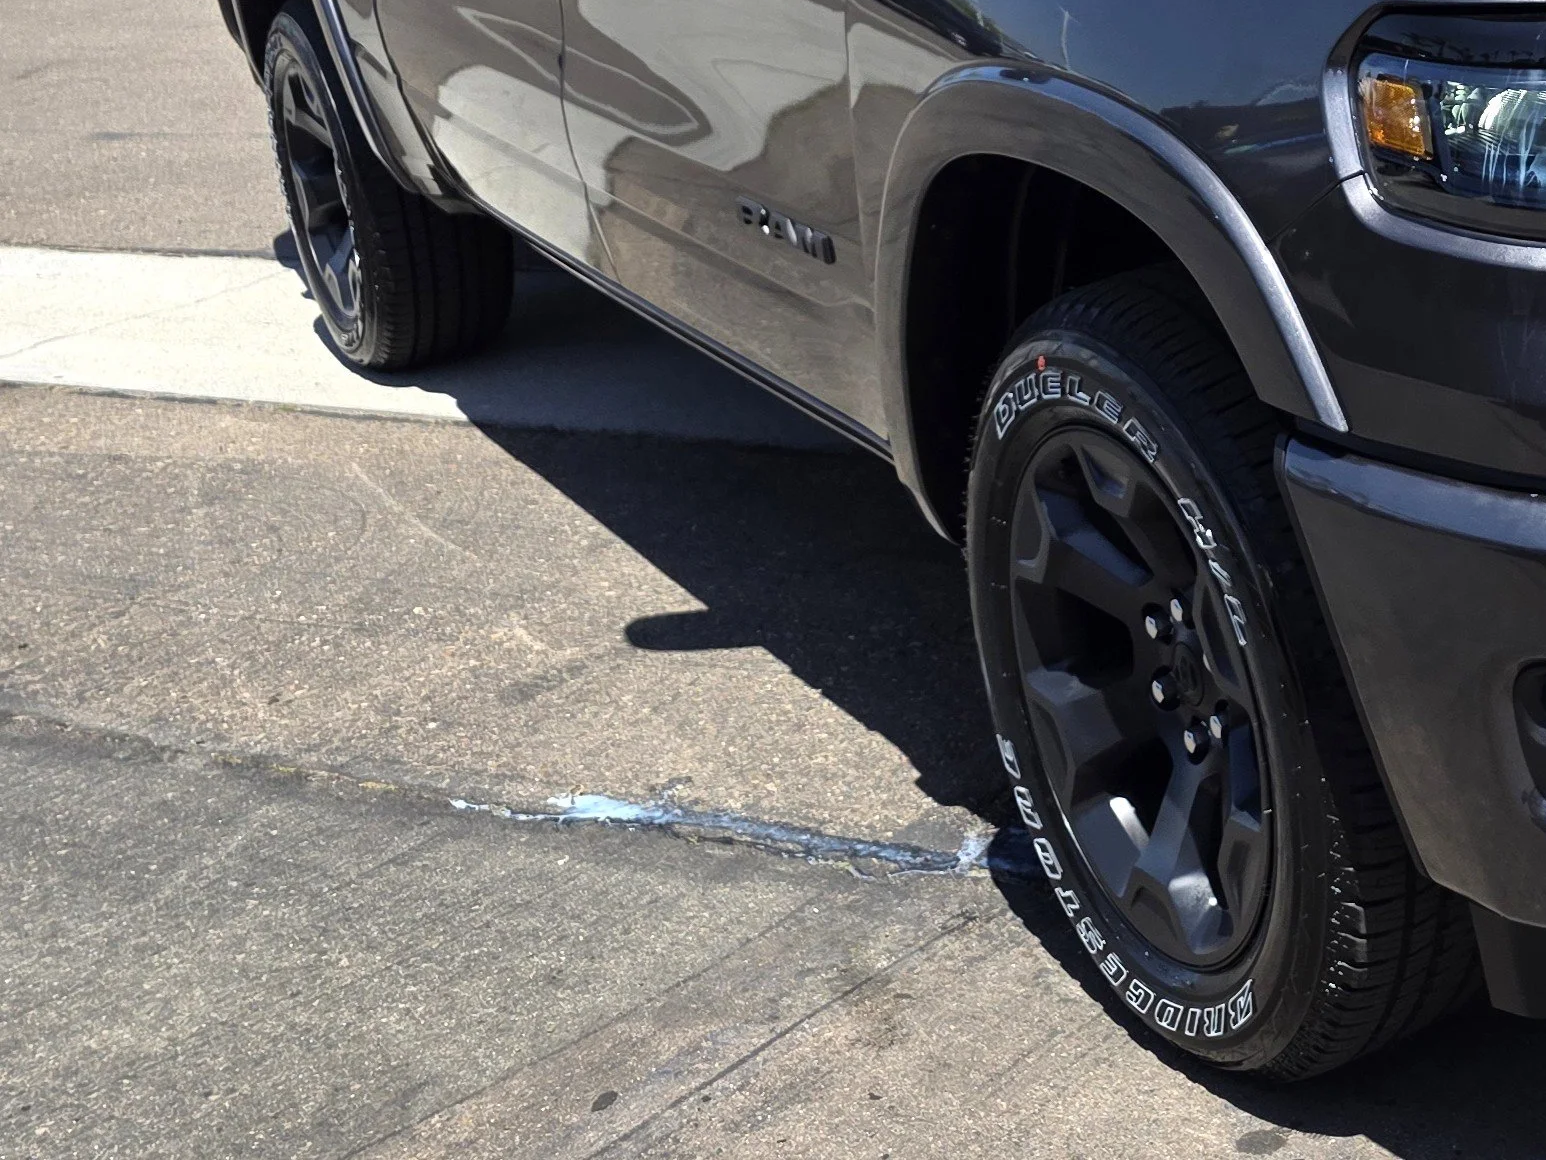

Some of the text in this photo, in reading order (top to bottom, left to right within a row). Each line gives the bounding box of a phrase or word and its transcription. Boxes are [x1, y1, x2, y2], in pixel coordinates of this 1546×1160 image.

[735, 195, 837, 265] RAM
[993, 369, 1159, 463] DUELER
[996, 733, 1254, 1037] BRIDGESTONE
